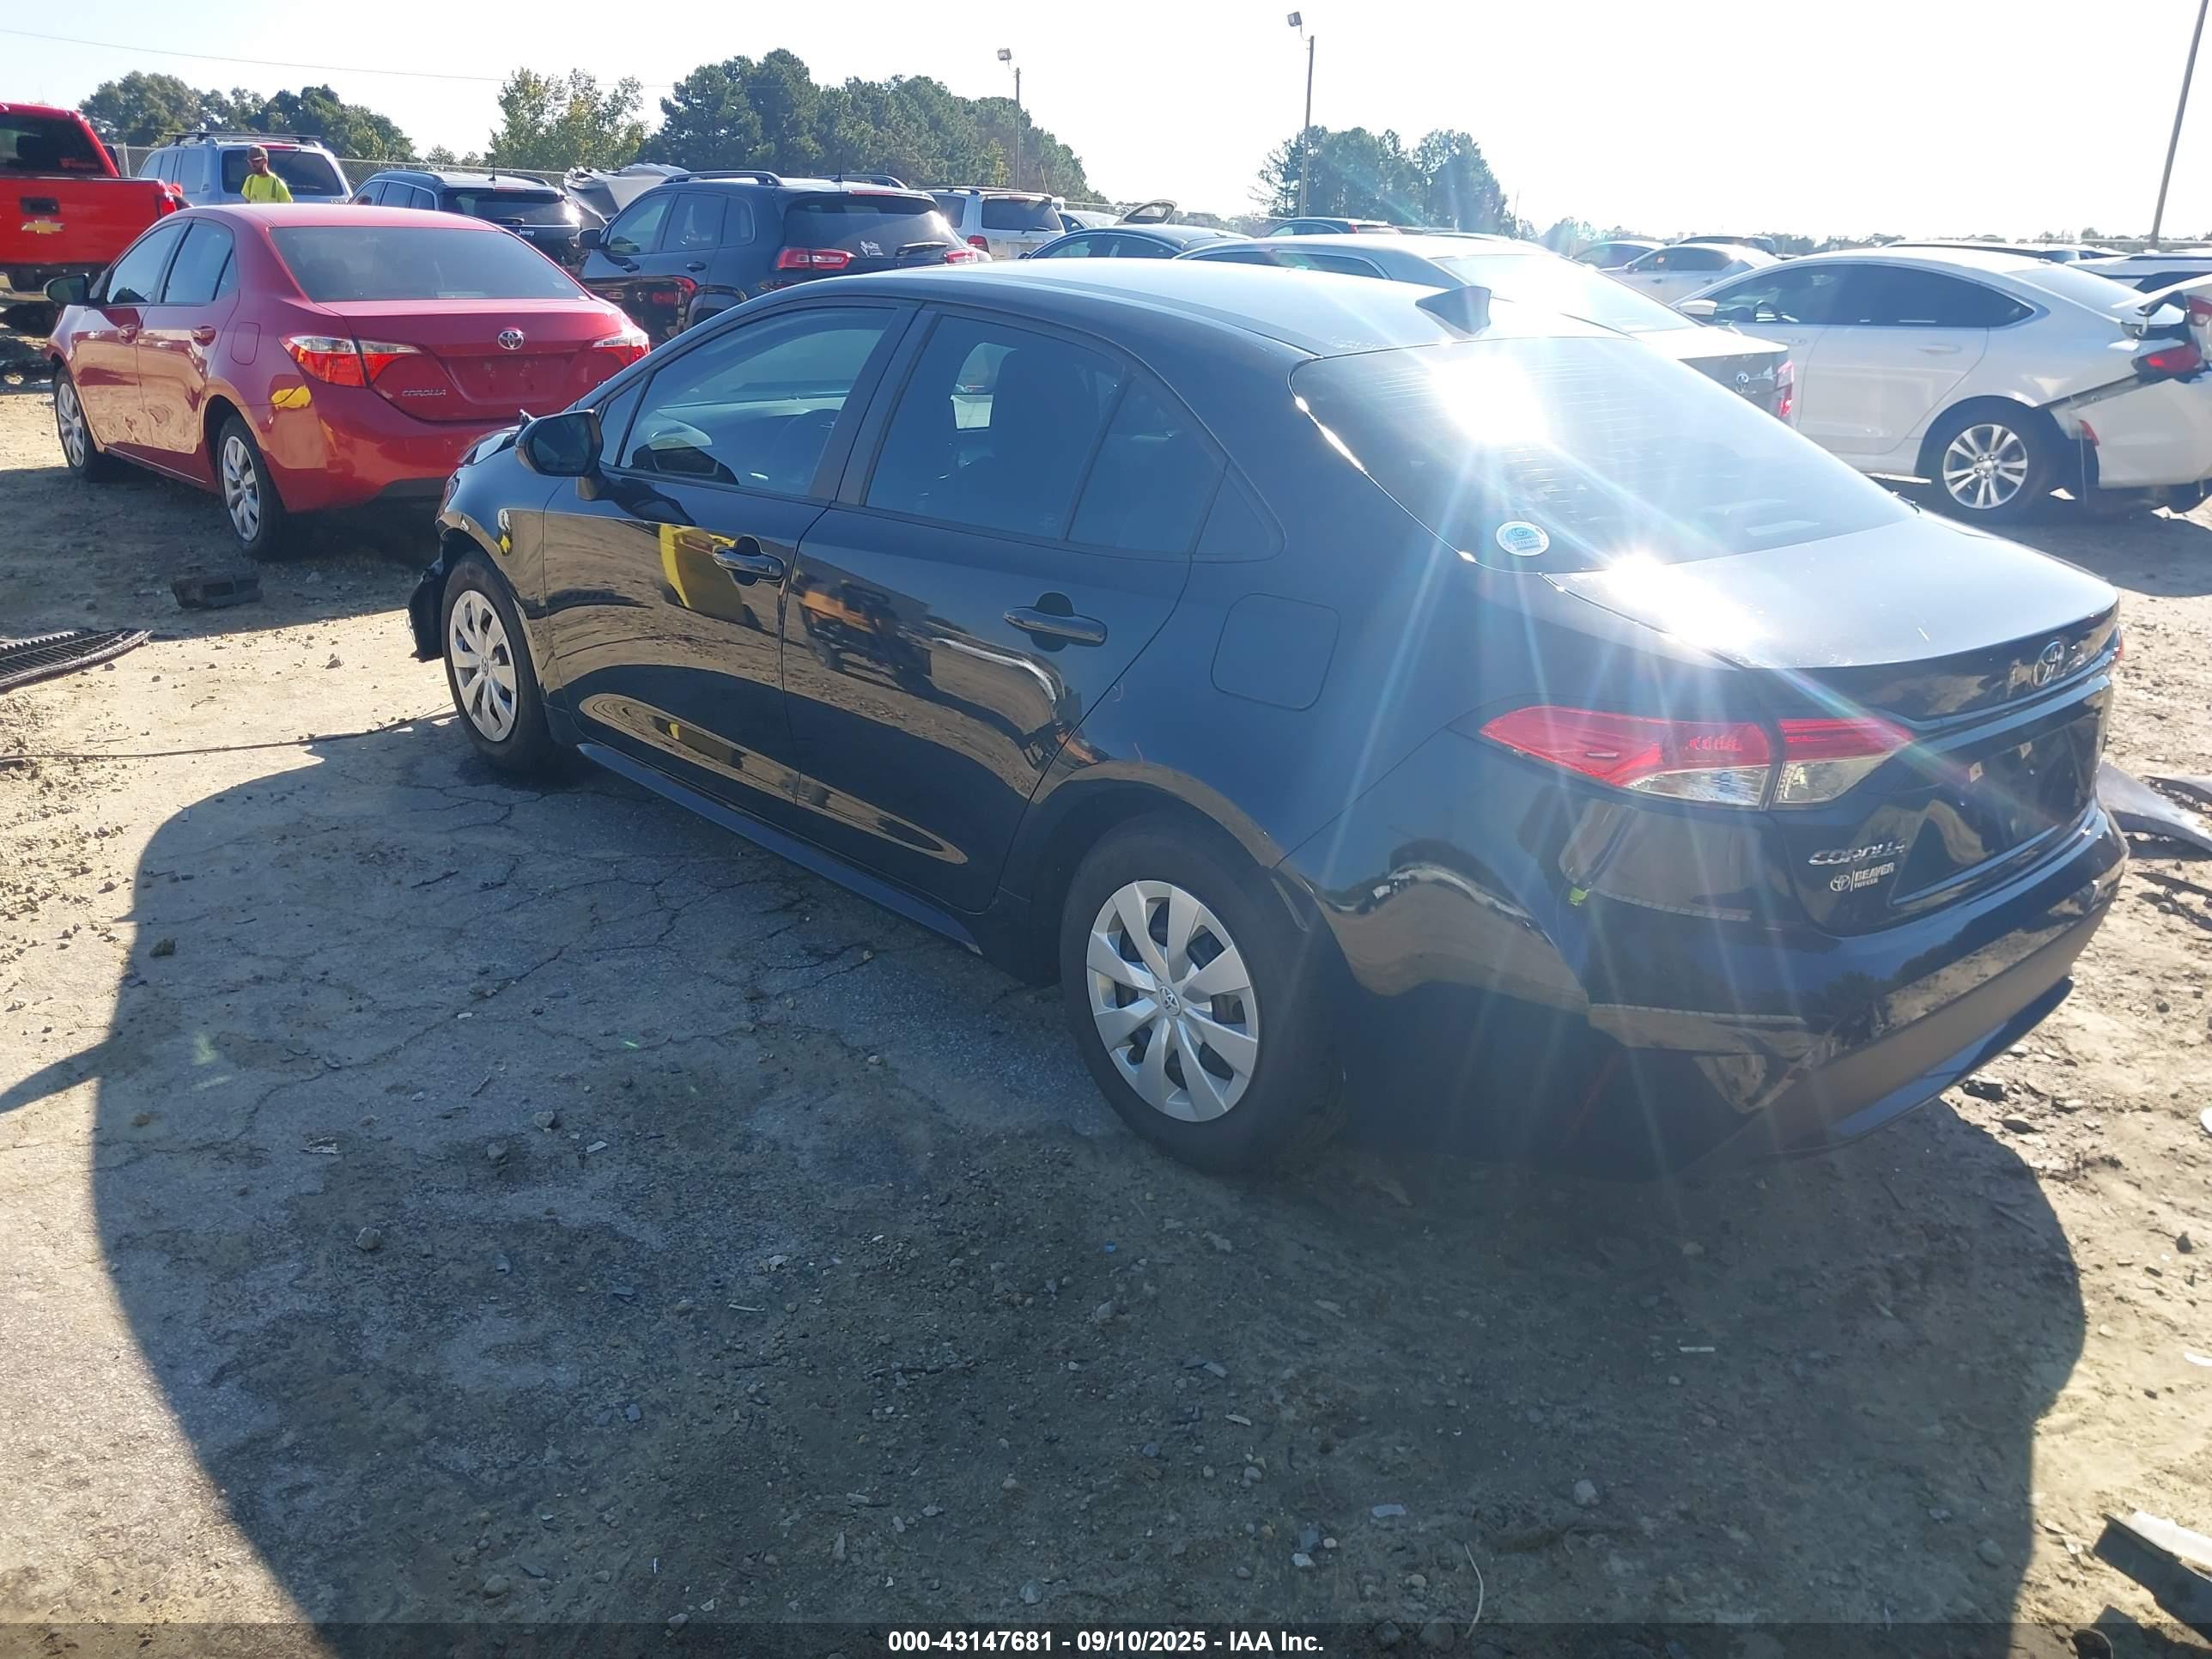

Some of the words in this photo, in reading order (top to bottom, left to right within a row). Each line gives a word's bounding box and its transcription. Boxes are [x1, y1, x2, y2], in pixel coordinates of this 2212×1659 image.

[517, 228, 535, 237] Jeep
[401, 388, 447, 398] COROLLA
[1854, 861, 1895, 882] BEAVER
